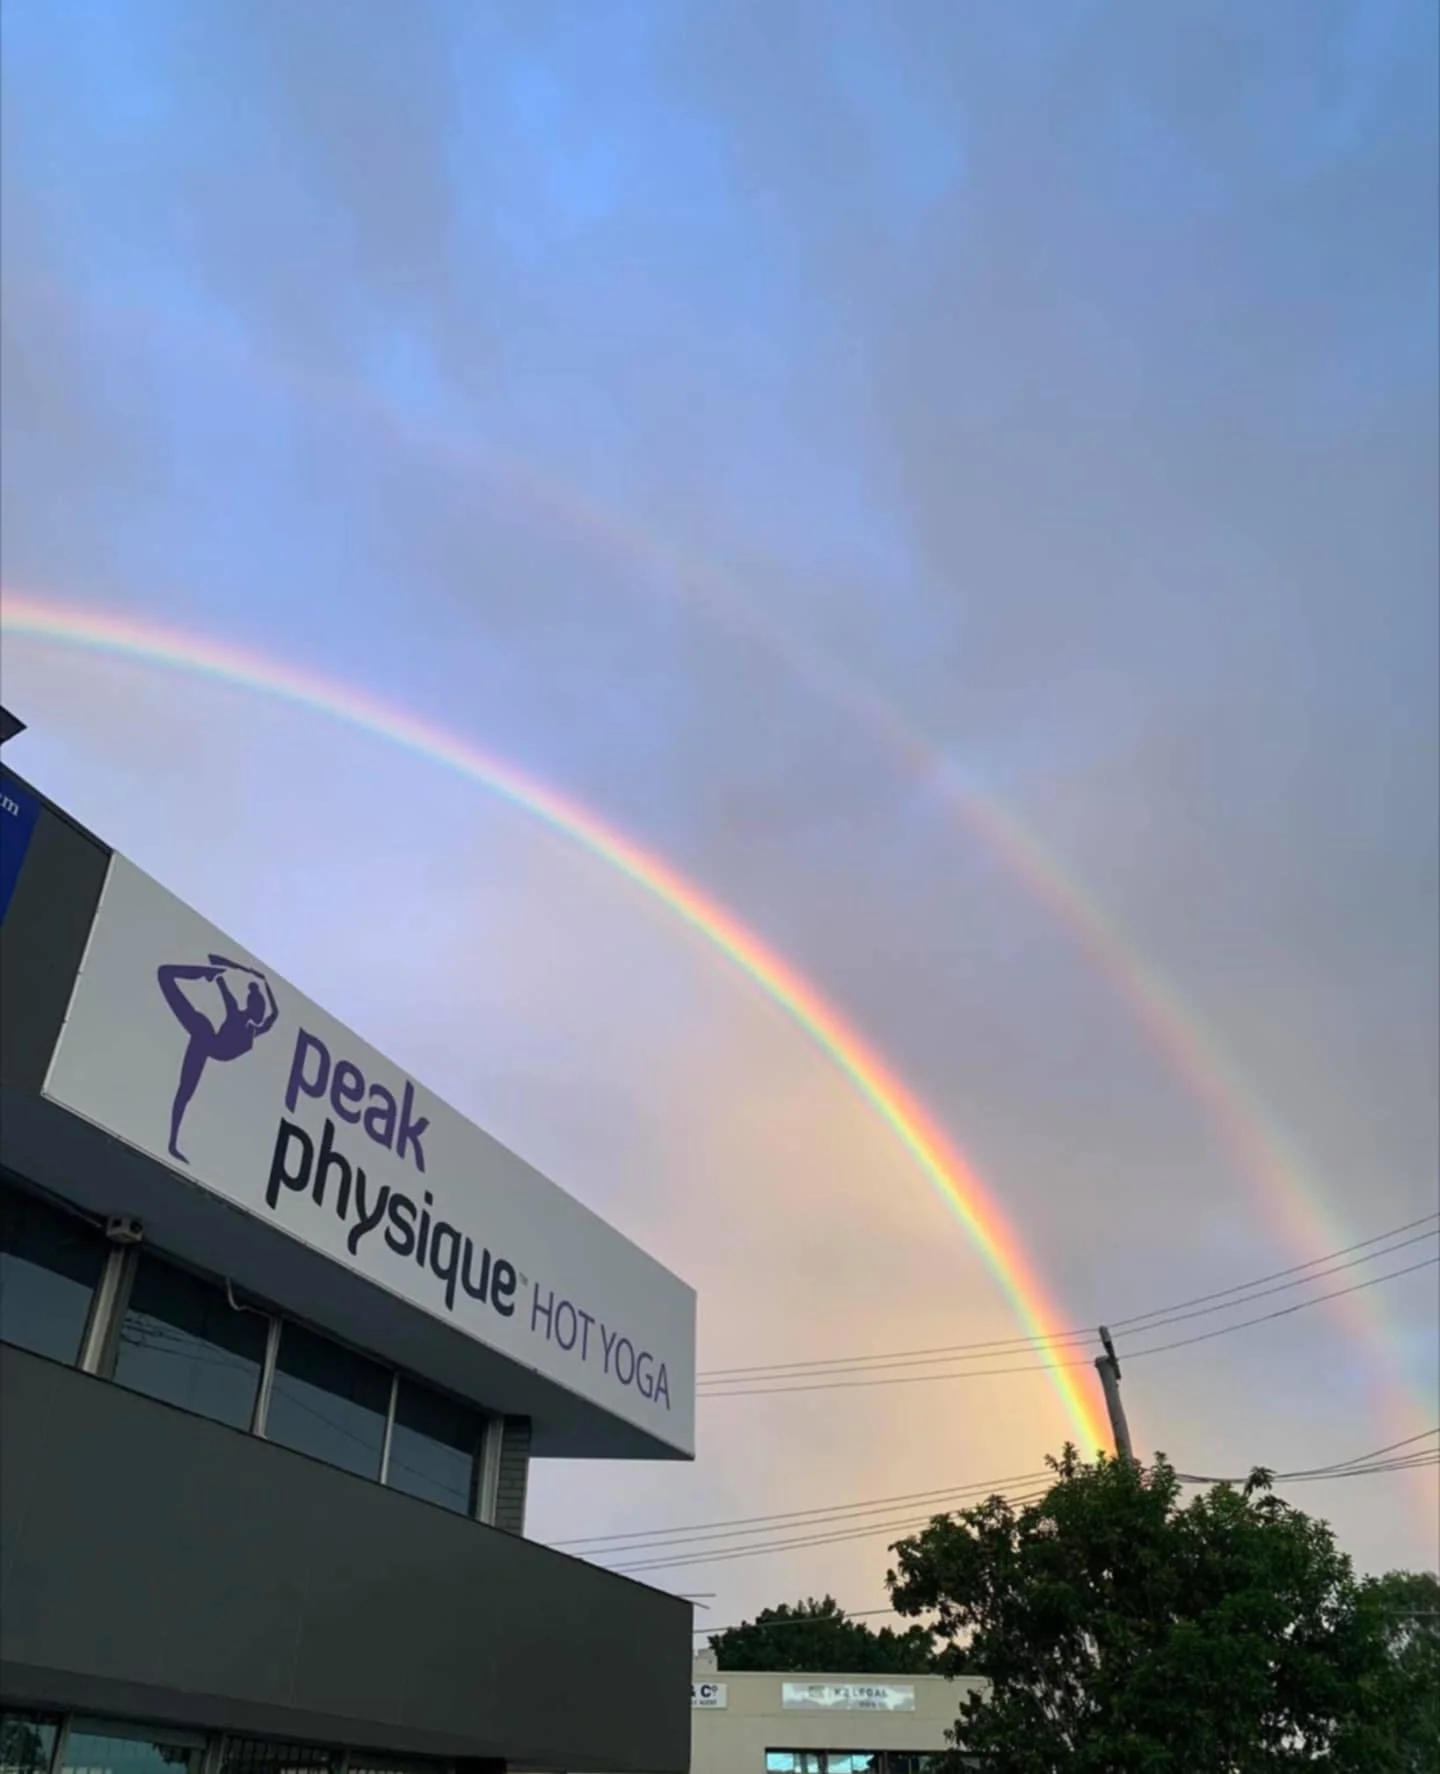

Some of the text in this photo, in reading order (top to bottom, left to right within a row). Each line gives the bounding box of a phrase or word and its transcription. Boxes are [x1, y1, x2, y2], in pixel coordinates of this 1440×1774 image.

[286, 1027, 430, 1173] peak
[266, 1117, 515, 1317] physique
[530, 1282, 594, 1361] HOT
[601, 1323, 671, 1411] YOGA
